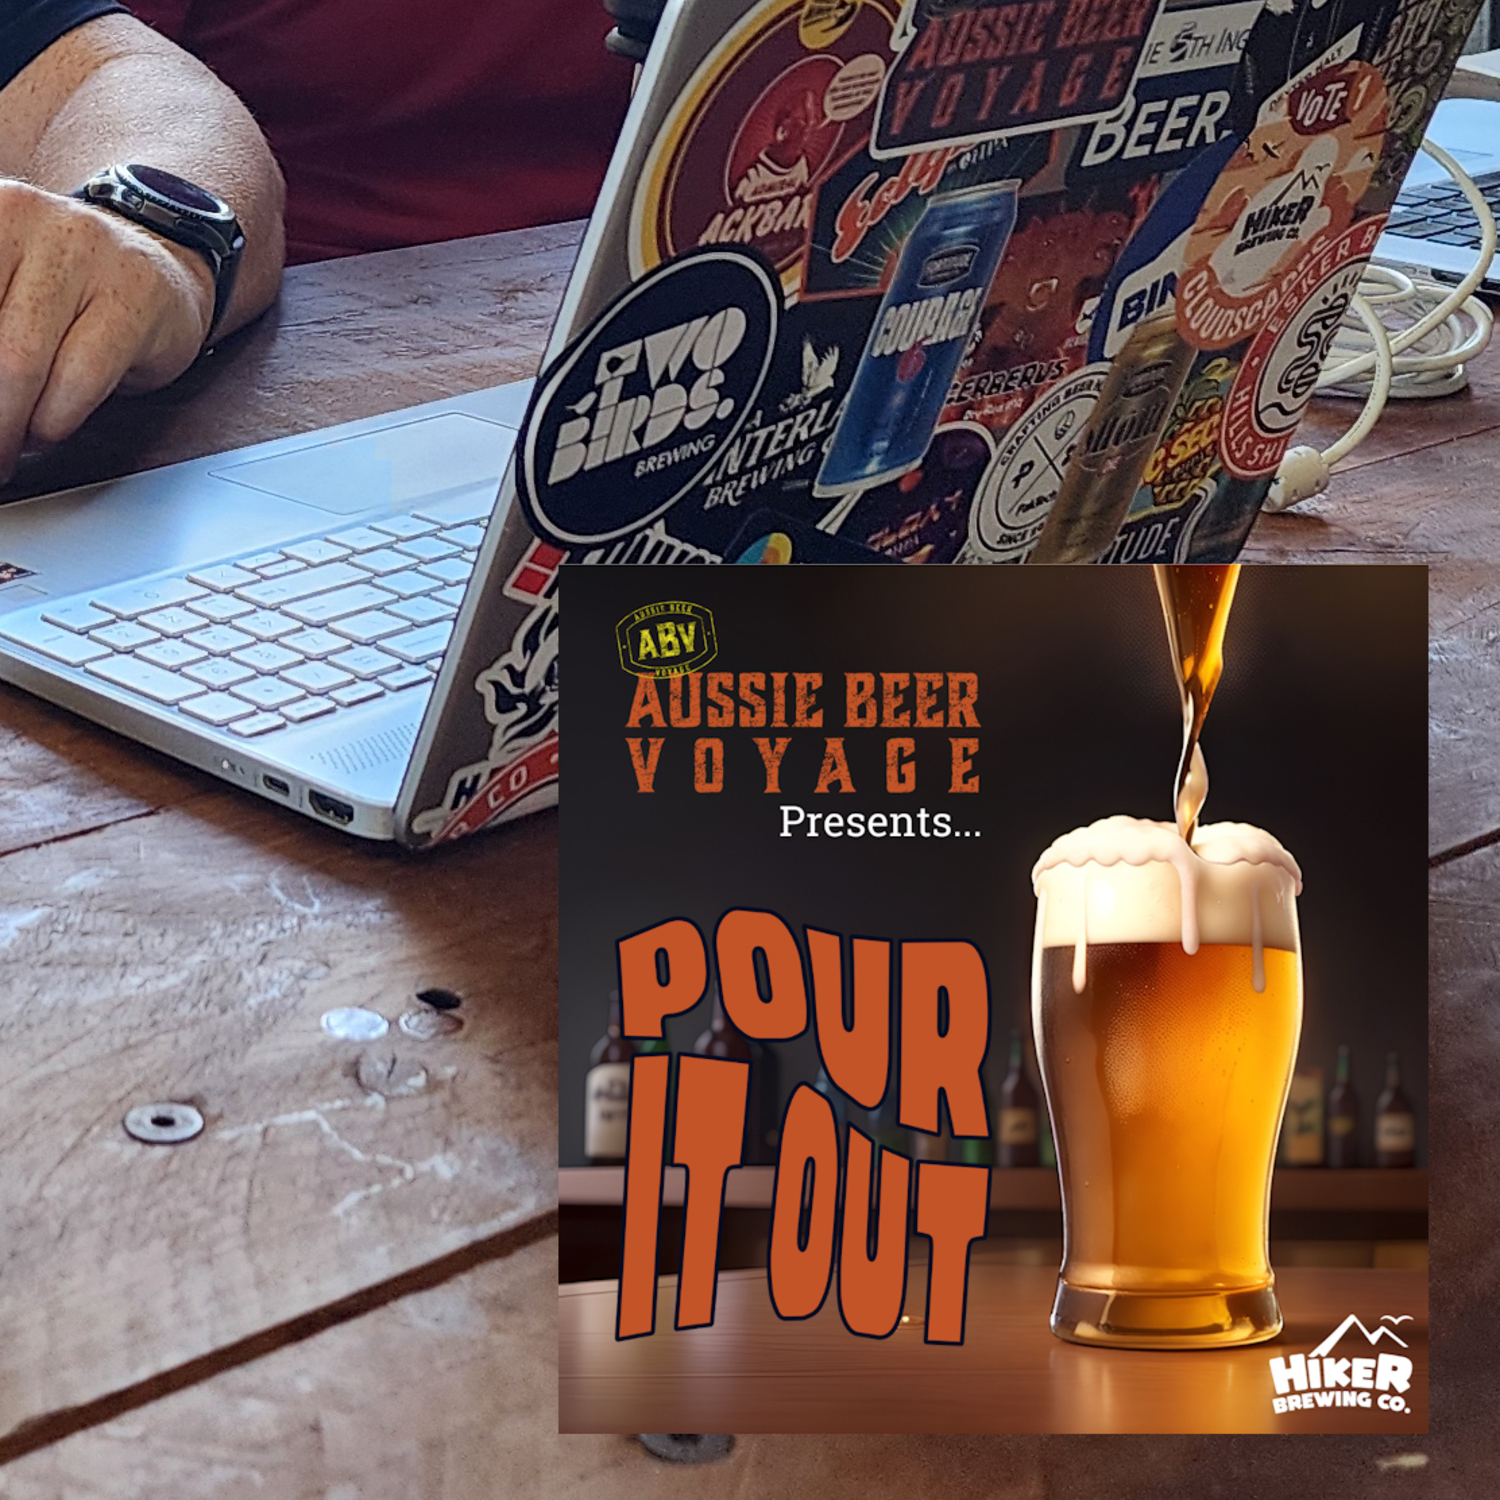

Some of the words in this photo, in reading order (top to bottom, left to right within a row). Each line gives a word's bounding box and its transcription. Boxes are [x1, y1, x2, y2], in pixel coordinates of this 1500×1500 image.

[904, 0, 1057, 74] AUSSIE
[889, 47, 1134, 136] VOYAGE
[1295, 80, 1348, 127] VOTE
[1241, 195, 1315, 240] HIKER
[1266, 237, 1351, 334] ESKER
[594, 306, 747, 396] TWO
[871, 287, 984, 358] COURAGE
[634, 433, 716, 479] BREWING
[1228, 384, 1254, 459] HILLS
[703, 441, 817, 511] BREWING
